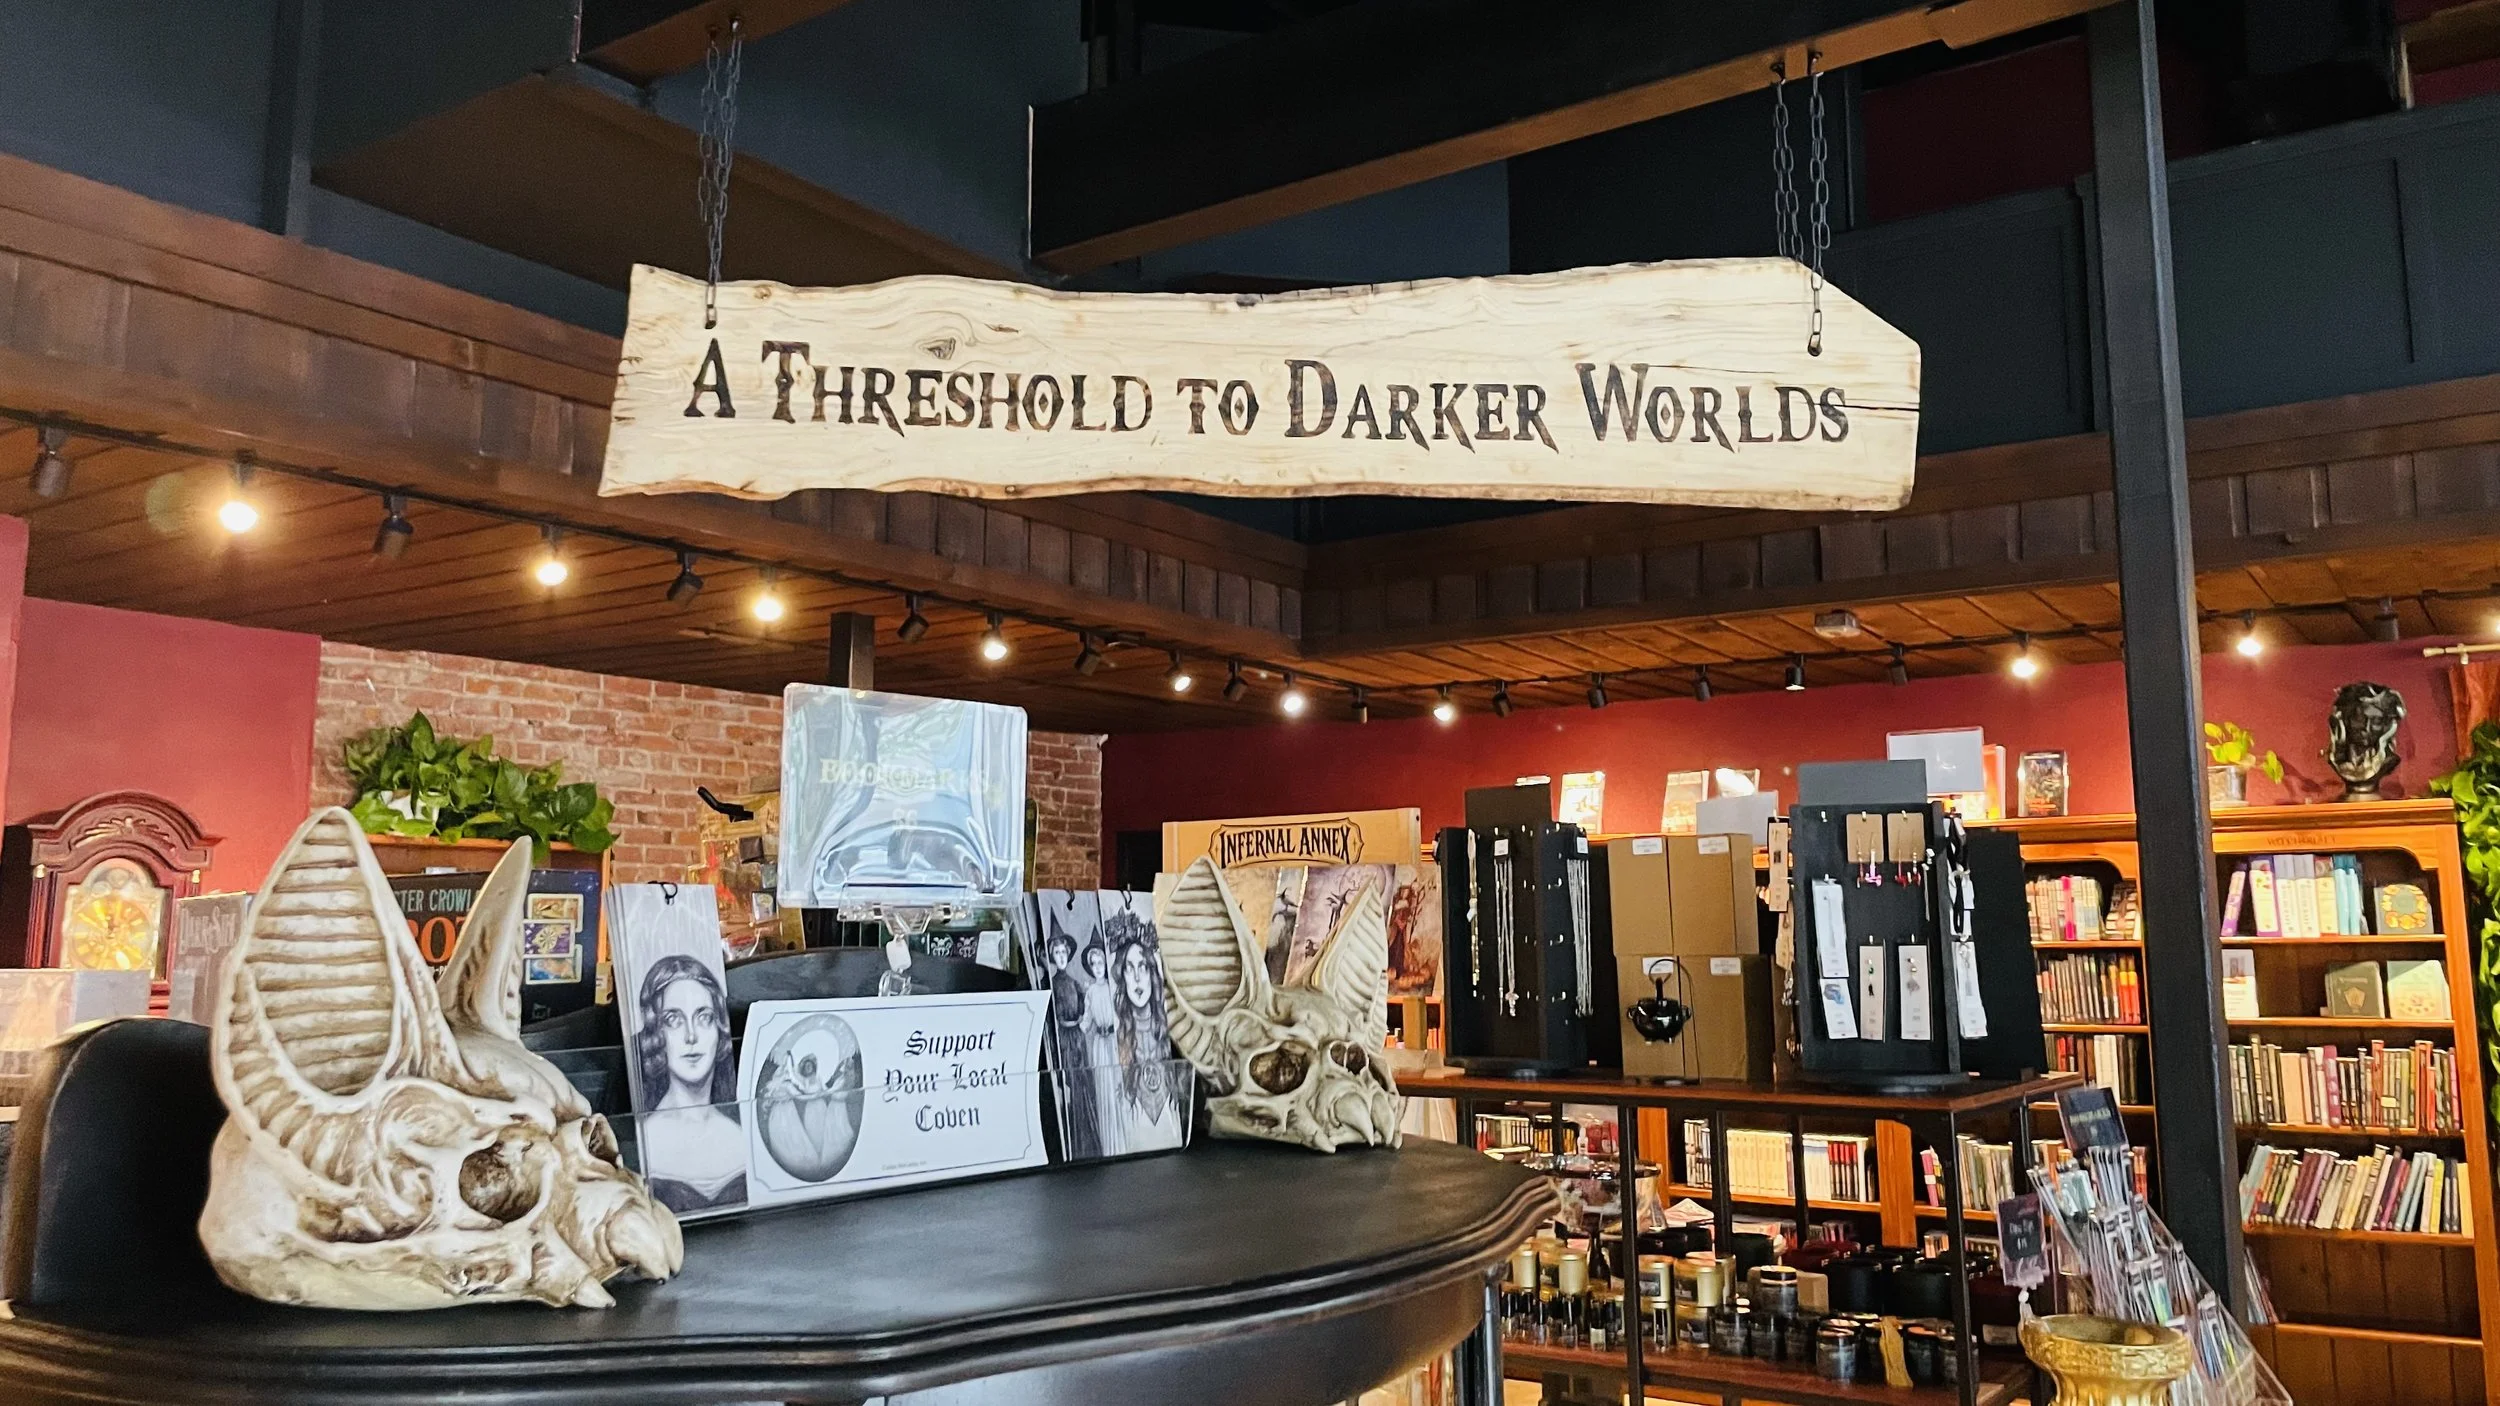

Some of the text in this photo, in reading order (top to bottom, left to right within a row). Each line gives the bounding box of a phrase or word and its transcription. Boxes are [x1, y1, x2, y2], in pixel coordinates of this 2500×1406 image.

[683, 337, 1850, 454] A THRESHOLD TO DARKER WORLDS
[1218, 825, 1351, 869] INFERNAL ANNEX
[429, 888, 481, 912] CROWL
[903, 1028, 996, 1058] Support
[882, 1060, 1008, 1103] Your Local
[915, 1104, 981, 1132] Coven
